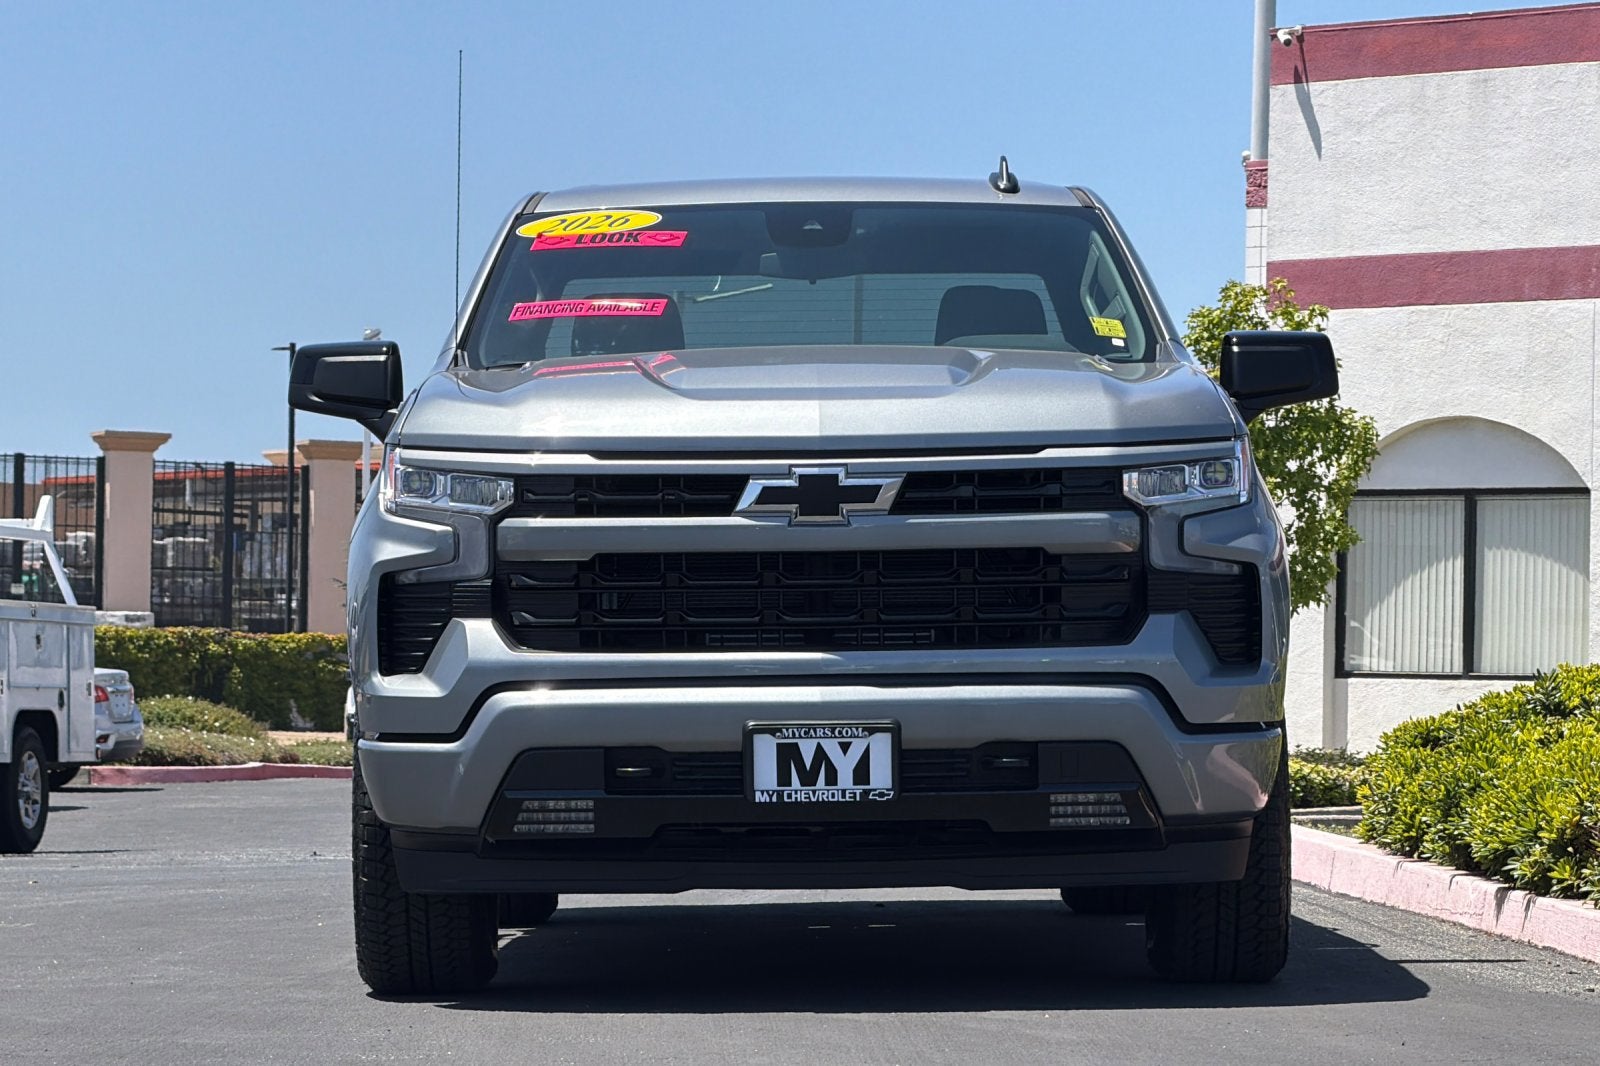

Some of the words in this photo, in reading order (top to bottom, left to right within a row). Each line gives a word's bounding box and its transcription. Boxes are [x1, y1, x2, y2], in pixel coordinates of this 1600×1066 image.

[543, 214, 638, 233] 2026
[575, 232, 644, 245] LOOK
[512, 302, 584, 317] FINANCING
[781, 727, 863, 738] MYCARS.COM
[776, 741, 870, 787] MY
[755, 791, 777, 802] MY
[783, 790, 862, 801] CHEVROLET
